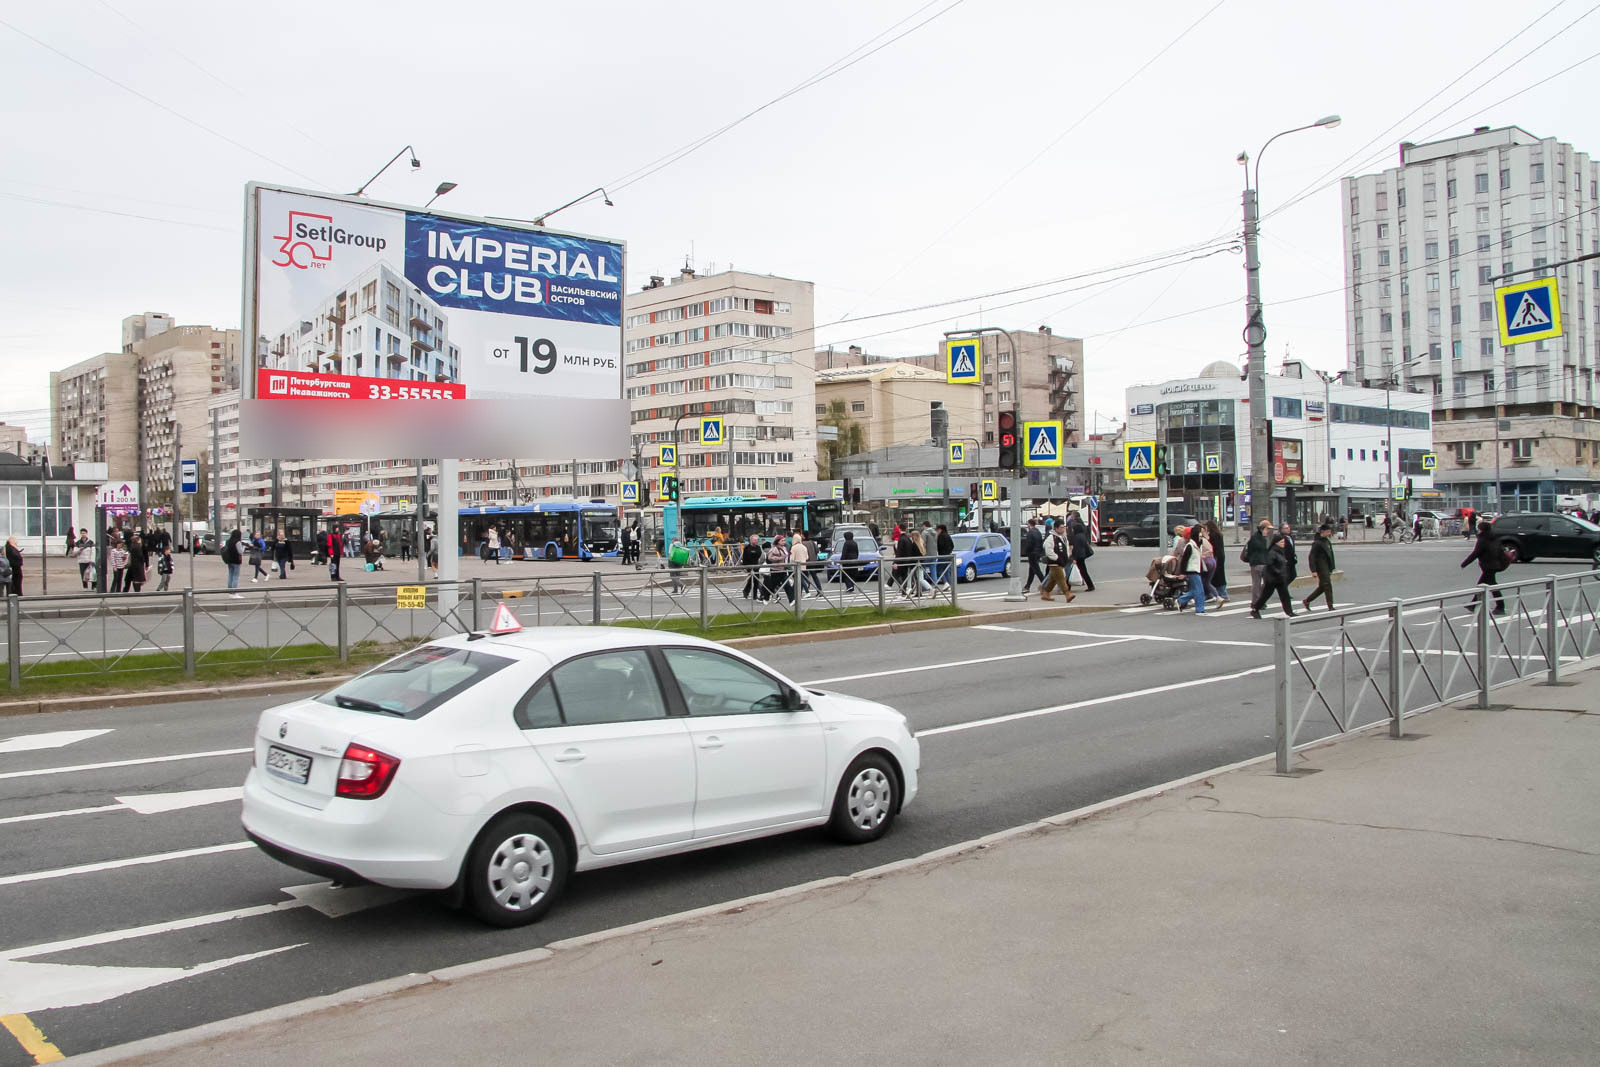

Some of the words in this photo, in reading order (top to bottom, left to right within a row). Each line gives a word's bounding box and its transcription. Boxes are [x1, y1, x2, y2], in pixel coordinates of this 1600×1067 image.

[427, 230, 618, 283] IMPERIAL
[310, 261, 327, 269] лет
[426, 265, 543, 304] CLUB
[551, 284, 618, 301] ВАСИЛЬЕВСКИЙ
[551, 295, 585, 306] ОСТРОВ
[514, 336, 558, 375] 19
[563, 354, 590, 367] МЛН
[290, 376, 351, 389] Петербургская
[290, 387, 351, 399] Недвижимость
[368, 384, 453, 400] 33-55555
